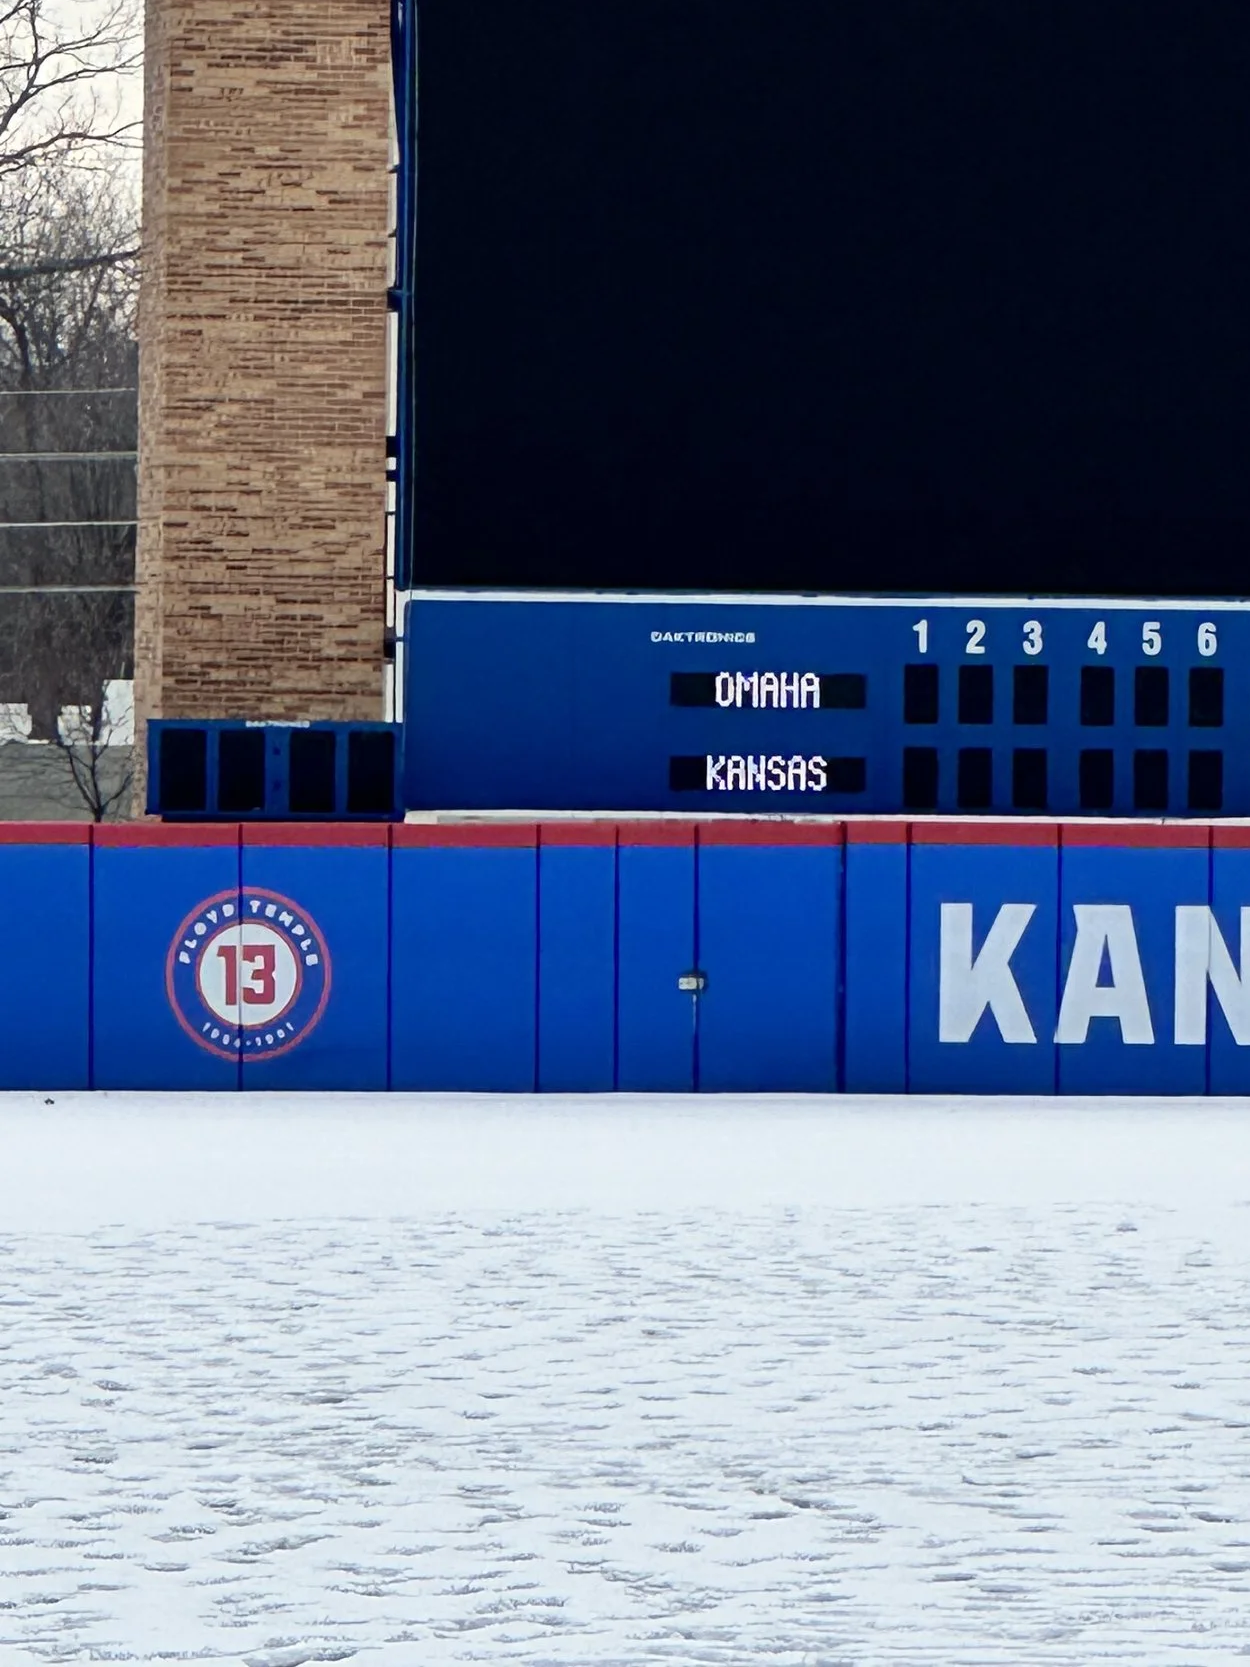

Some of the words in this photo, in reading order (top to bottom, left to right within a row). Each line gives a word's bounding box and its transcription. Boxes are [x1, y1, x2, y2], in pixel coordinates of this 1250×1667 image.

[912, 619, 928, 654] 1
[965, 619, 986, 654] 2
[1022, 620, 1043, 656] 3
[1087, 621, 1108, 655] 4
[1142, 621, 1162, 656] 5
[1197, 622, 1217, 657] 6
[715, 671, 821, 709] OMAHA
[706, 754, 828, 792] KANSAS
[215, 944, 277, 1007] 13
